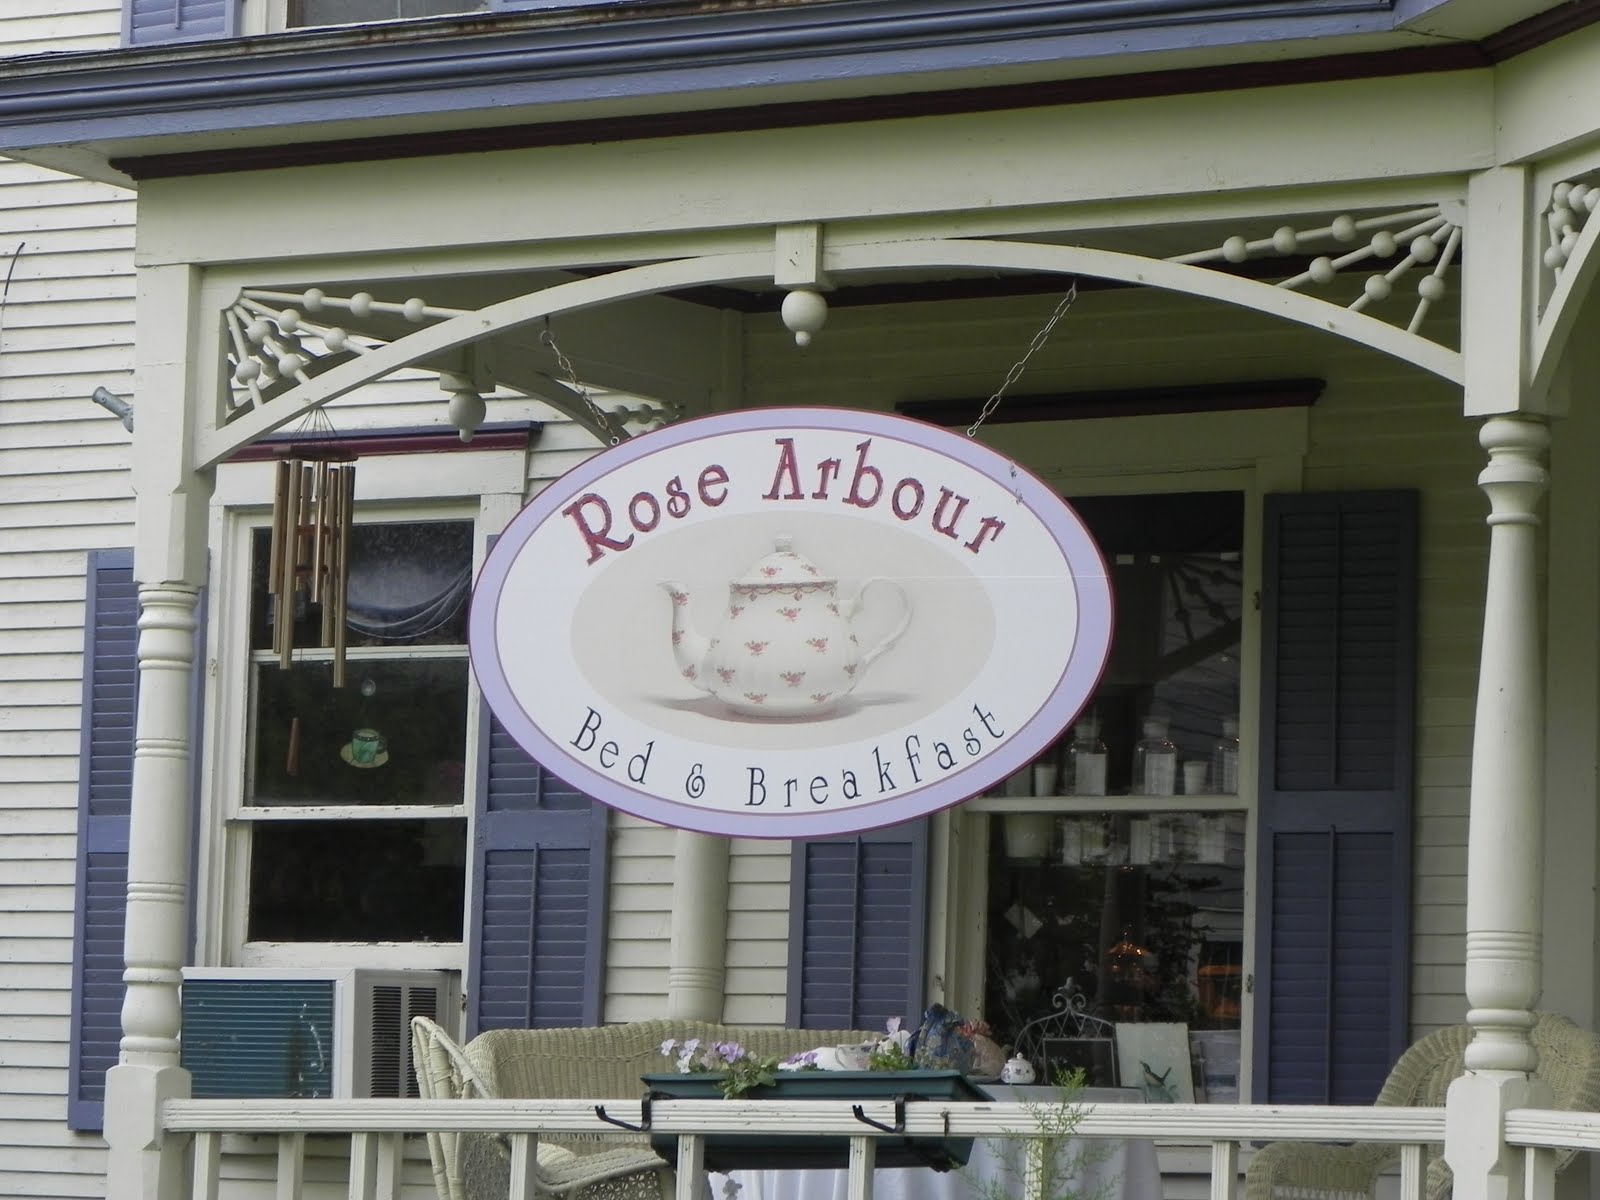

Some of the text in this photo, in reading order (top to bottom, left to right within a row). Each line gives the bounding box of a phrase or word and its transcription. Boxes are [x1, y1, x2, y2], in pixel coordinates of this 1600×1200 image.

[561, 437, 1006, 566] Rose Arbour
[570, 703, 1005, 808] Bed & Breakfast
